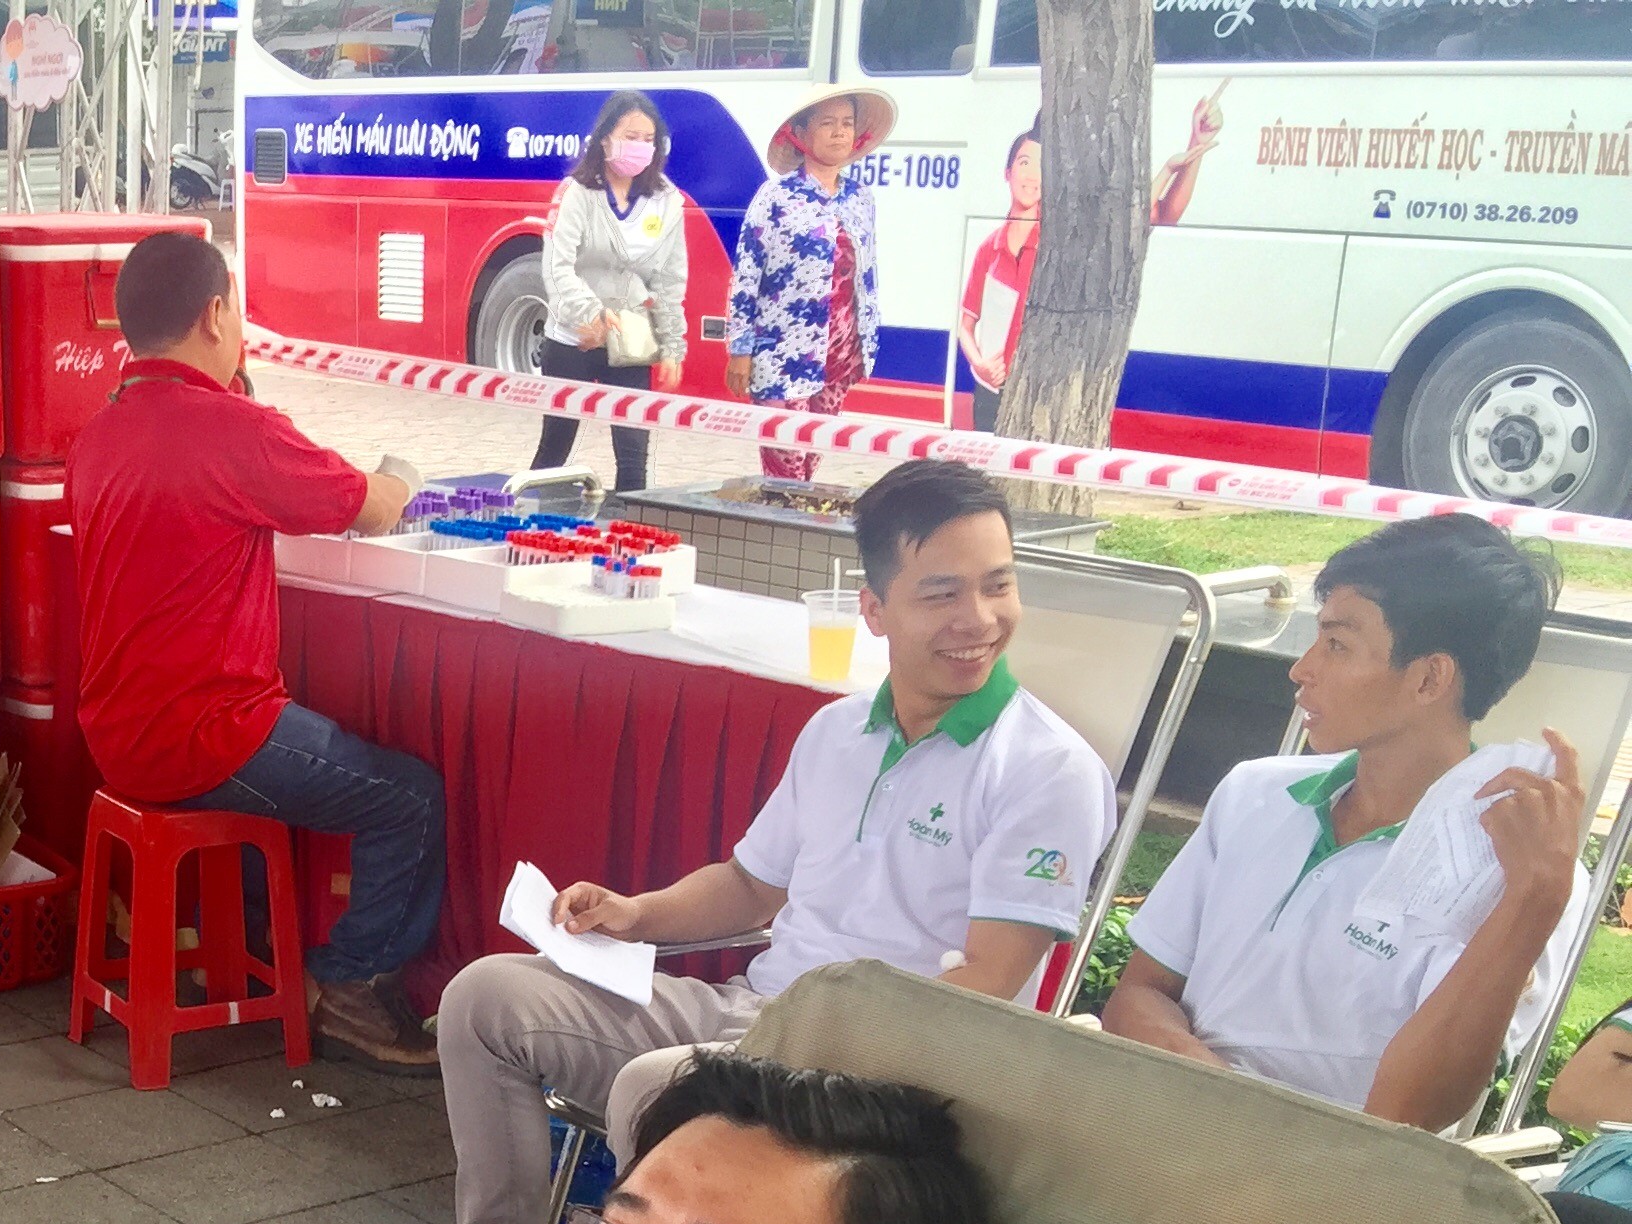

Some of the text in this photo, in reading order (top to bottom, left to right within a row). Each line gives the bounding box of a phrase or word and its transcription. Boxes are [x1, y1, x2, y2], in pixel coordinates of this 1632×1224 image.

[294, 122, 315, 155] XE
[317, 112, 353, 156] HIẾN
[356, 112, 392, 156] MÁU
[429, 118, 481, 161] ĐỘNG
[529, 134, 580, 158] (0710)
[1256, 117, 1312, 174] BỆNH
[1316, 117, 1363, 176] VIỆN
[1364, 111, 1435, 170] HUYẾT
[1437, 128, 1484, 180] HỌC
[1504, 109, 1593, 175] TRUYỀN
[1405, 200, 1579, 226] (0710) 38.26.209
[53, 341, 105, 378] Hiệp
[1344, 923, 1377, 948] Hoàn
